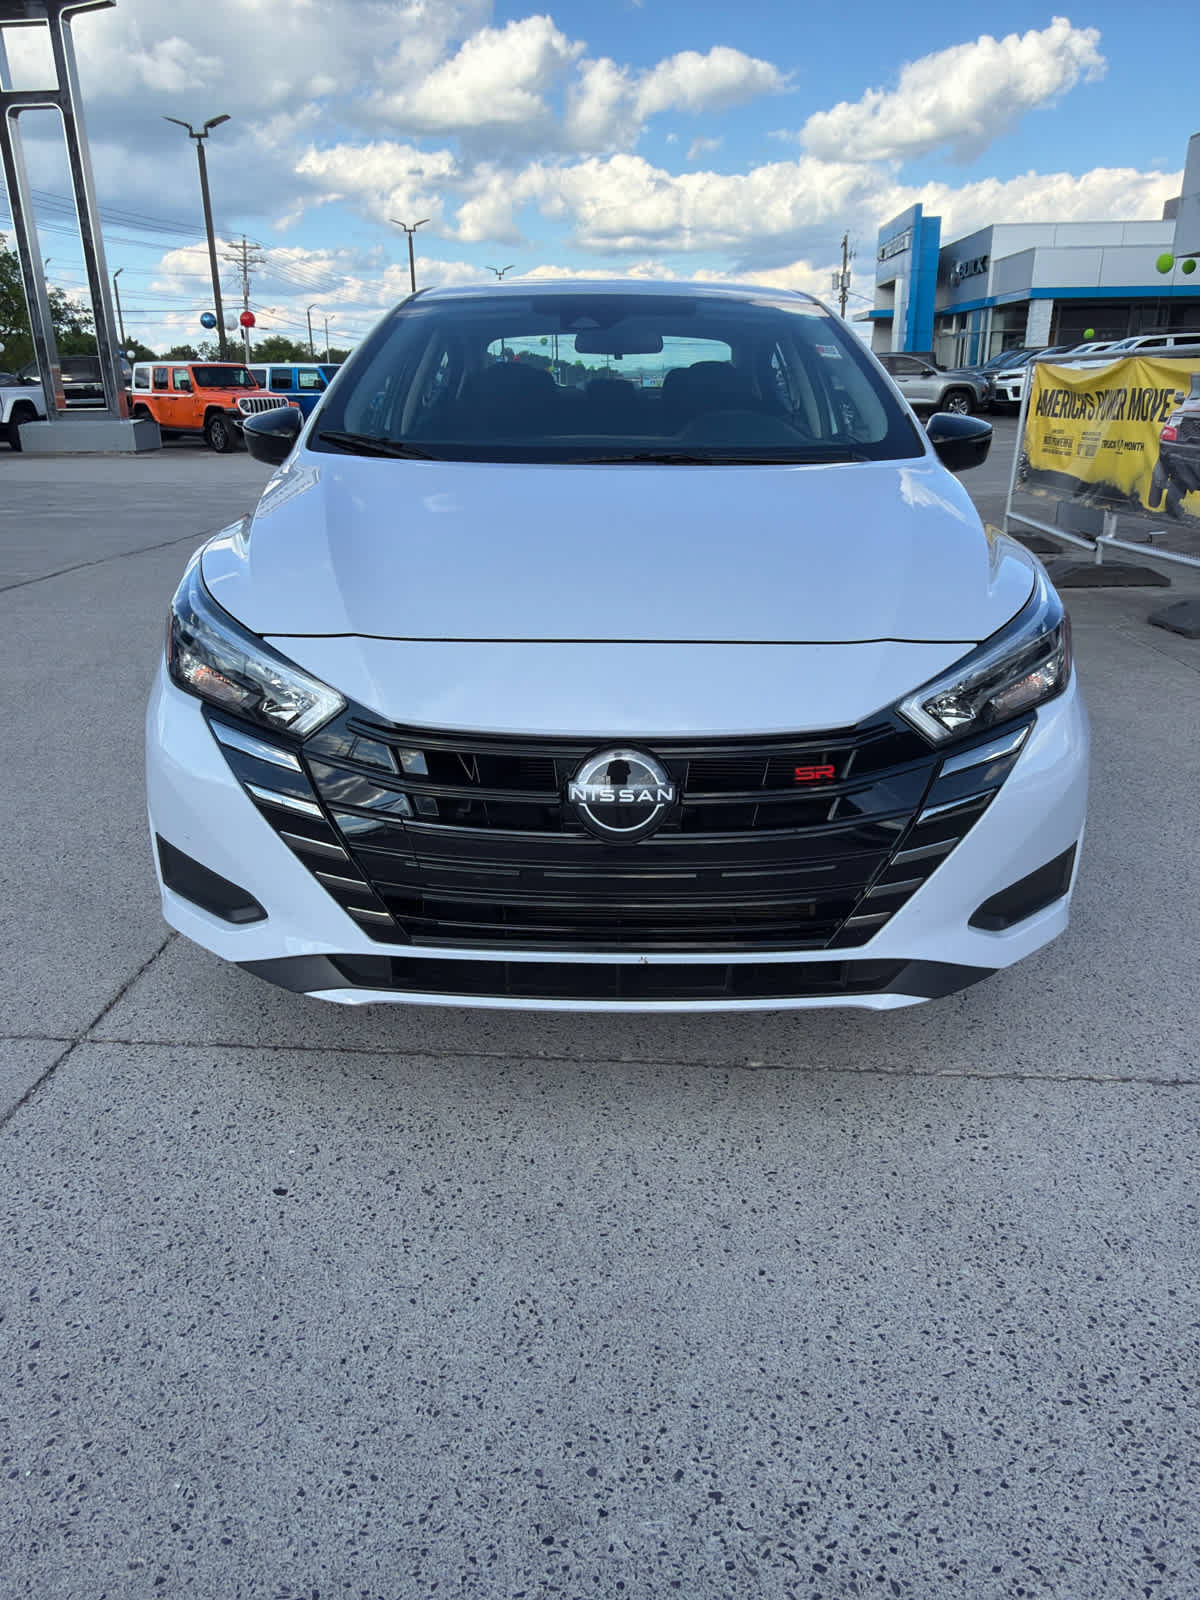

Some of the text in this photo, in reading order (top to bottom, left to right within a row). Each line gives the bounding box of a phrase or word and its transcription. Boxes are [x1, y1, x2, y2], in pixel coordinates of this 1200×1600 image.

[1036, 388, 1095, 420] AMERICA'S
[1128, 388, 1175, 422] MOVE
[1124, 440, 1145, 451] MONTH
[795, 765, 835, 781] SR
[570, 788, 673, 802] NISSAN
